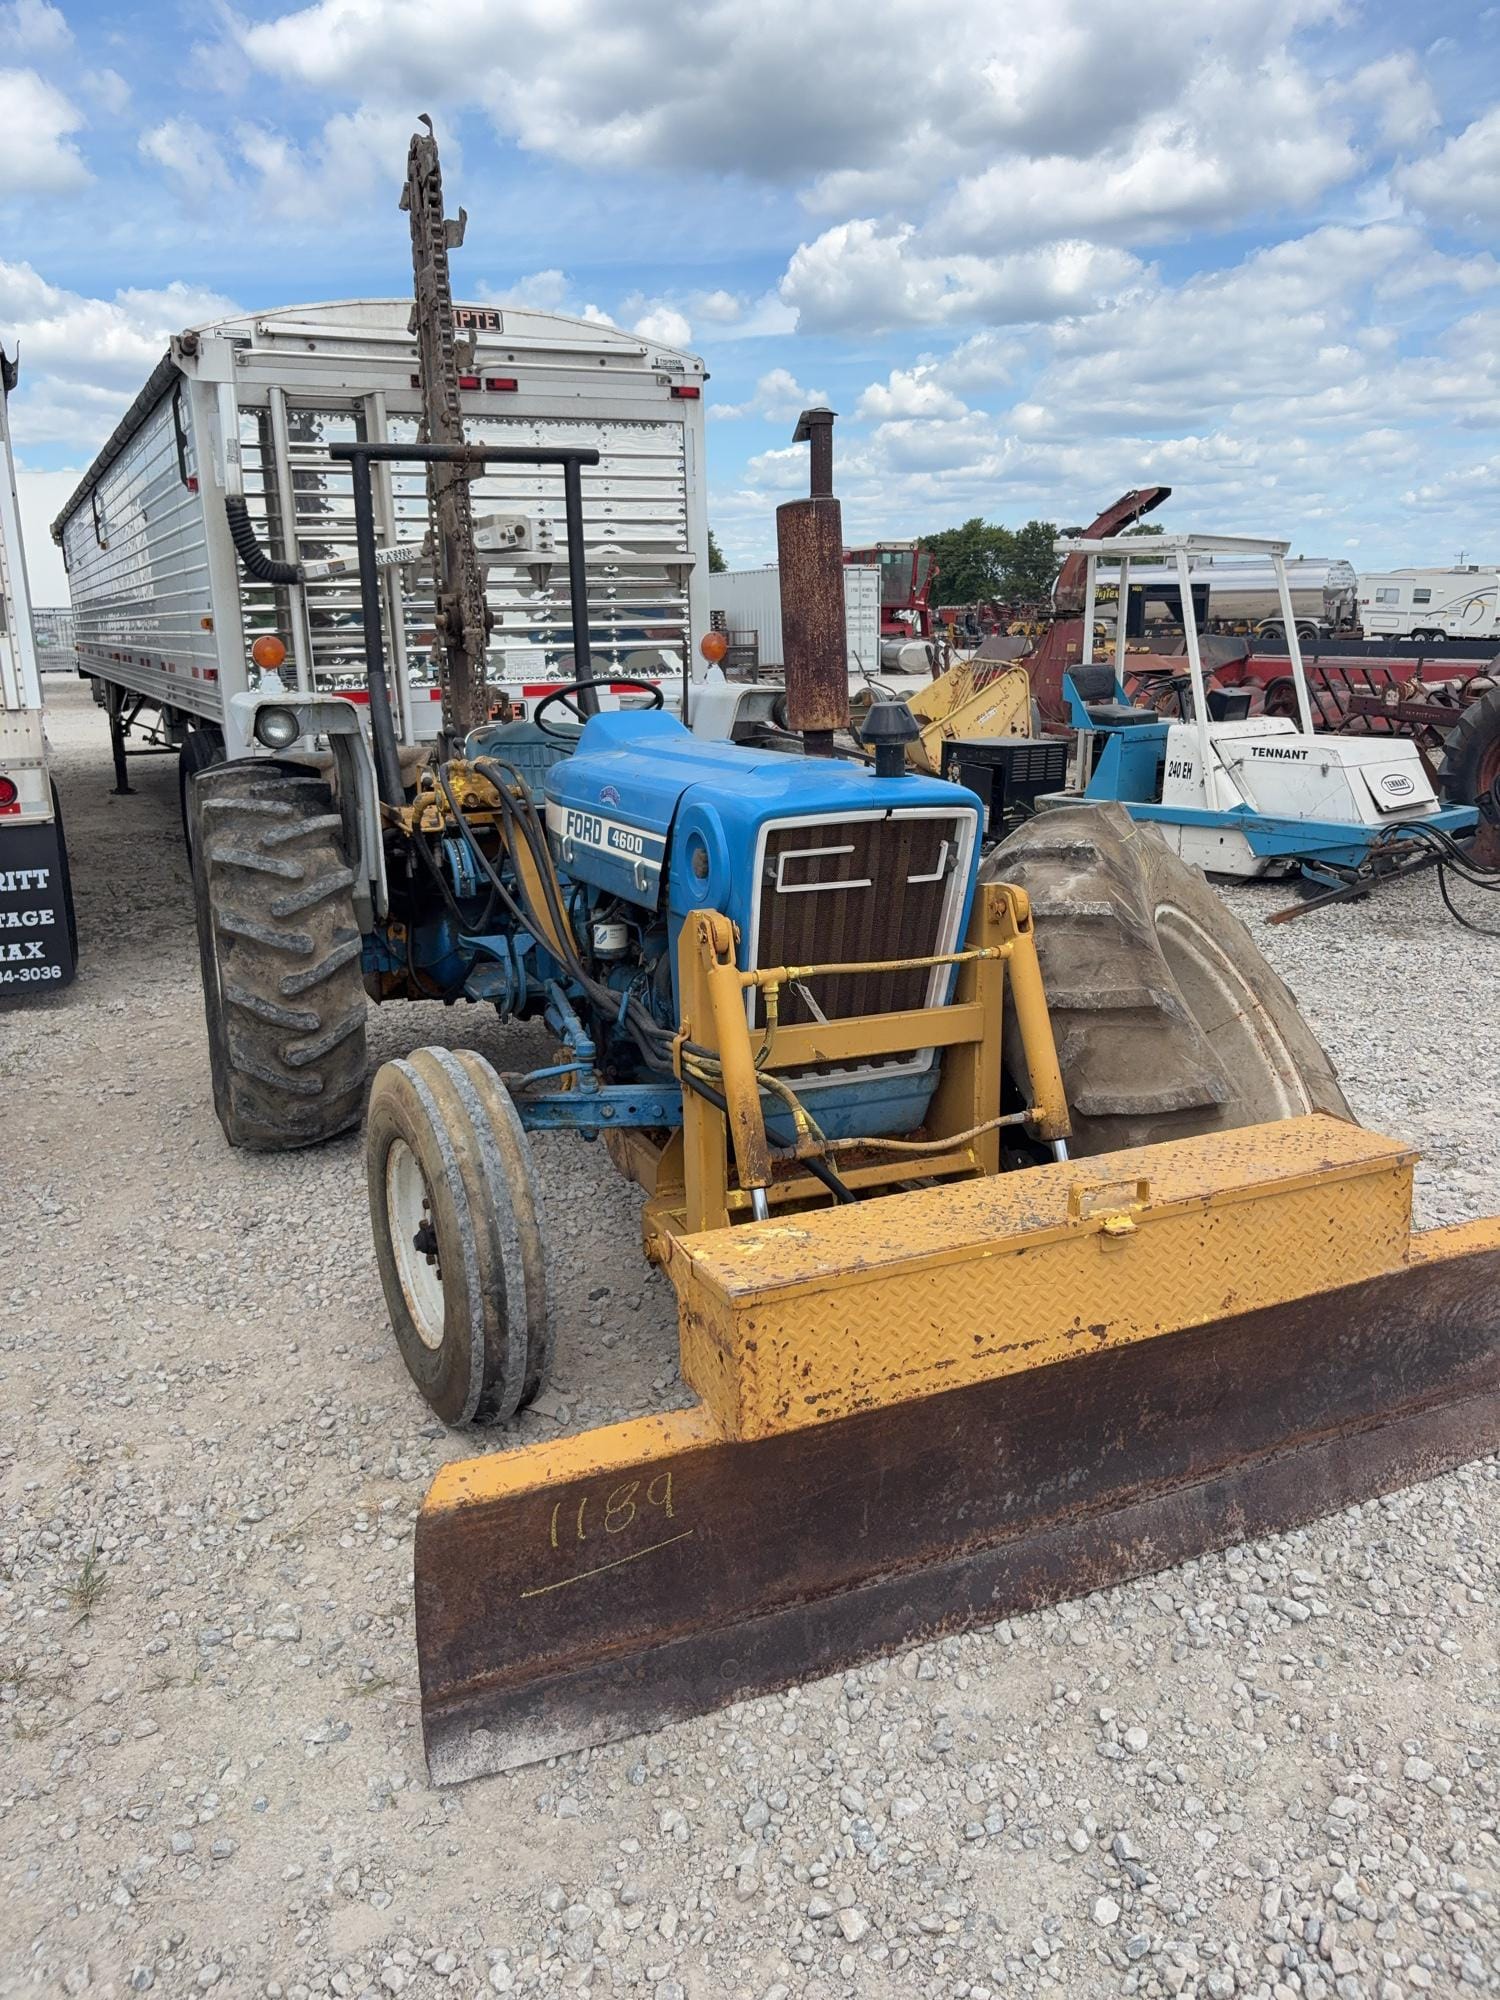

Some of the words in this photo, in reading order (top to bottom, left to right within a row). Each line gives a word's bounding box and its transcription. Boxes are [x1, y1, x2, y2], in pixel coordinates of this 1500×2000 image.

[1251, 747, 1308, 760] TENNANT
[1168, 761, 1181, 778] 240
[1182, 763, 1193, 779] EH
[566, 811, 602, 845] FORD
[612, 830, 643, 854] 4600
[0, 966, 62, 984] 4-3036
[550, 1472, 675, 1548] 1189
